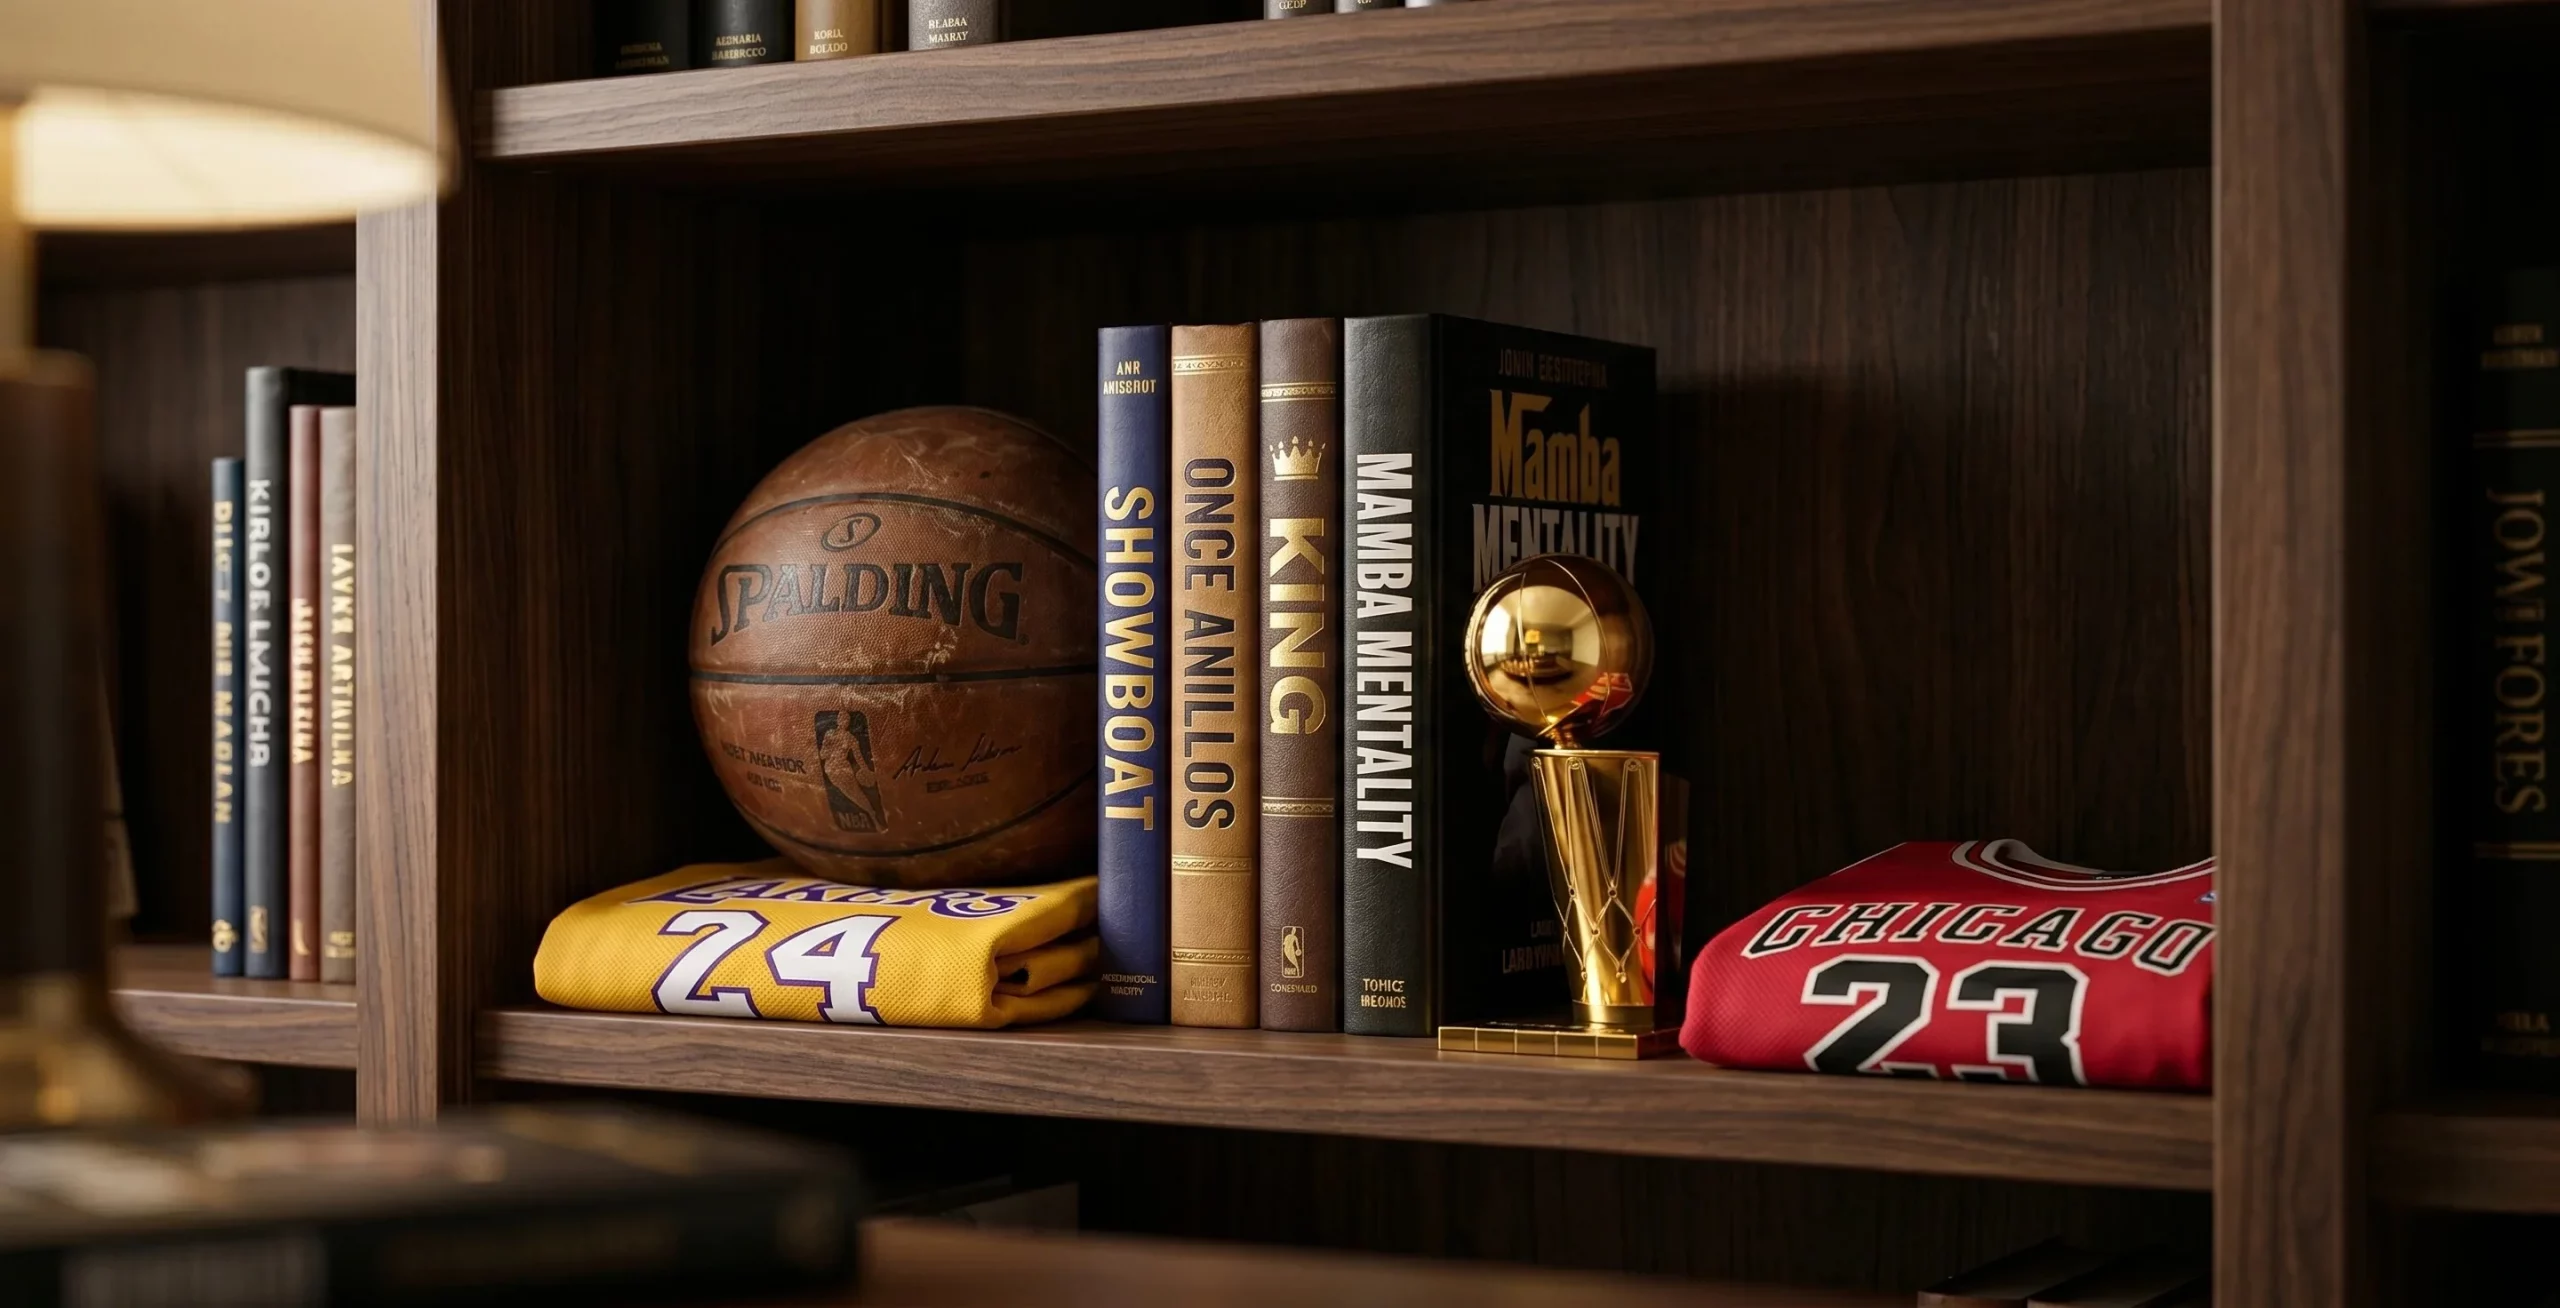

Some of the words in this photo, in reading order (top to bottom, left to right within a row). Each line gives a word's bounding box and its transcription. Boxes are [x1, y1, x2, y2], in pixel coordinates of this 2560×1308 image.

[1489, 388, 1622, 508] Mamba
[1183, 458, 1236, 591] ONCE
[1357, 453, 1413, 619] MAMBA
[711, 562, 1023, 647] SPALDING
[1104, 486, 1155, 831] SHOWBOAT
[1269, 518, 1326, 734] KING
[1183, 610, 1236, 830] ANILLOS
[1357, 631, 1413, 868] MENTALITY
[621, 877, 1040, 919] LAKERS
[1741, 902, 2216, 977] CHICAGO
[652, 909, 902, 1024] 24
[1800, 953, 2089, 1085] 23
